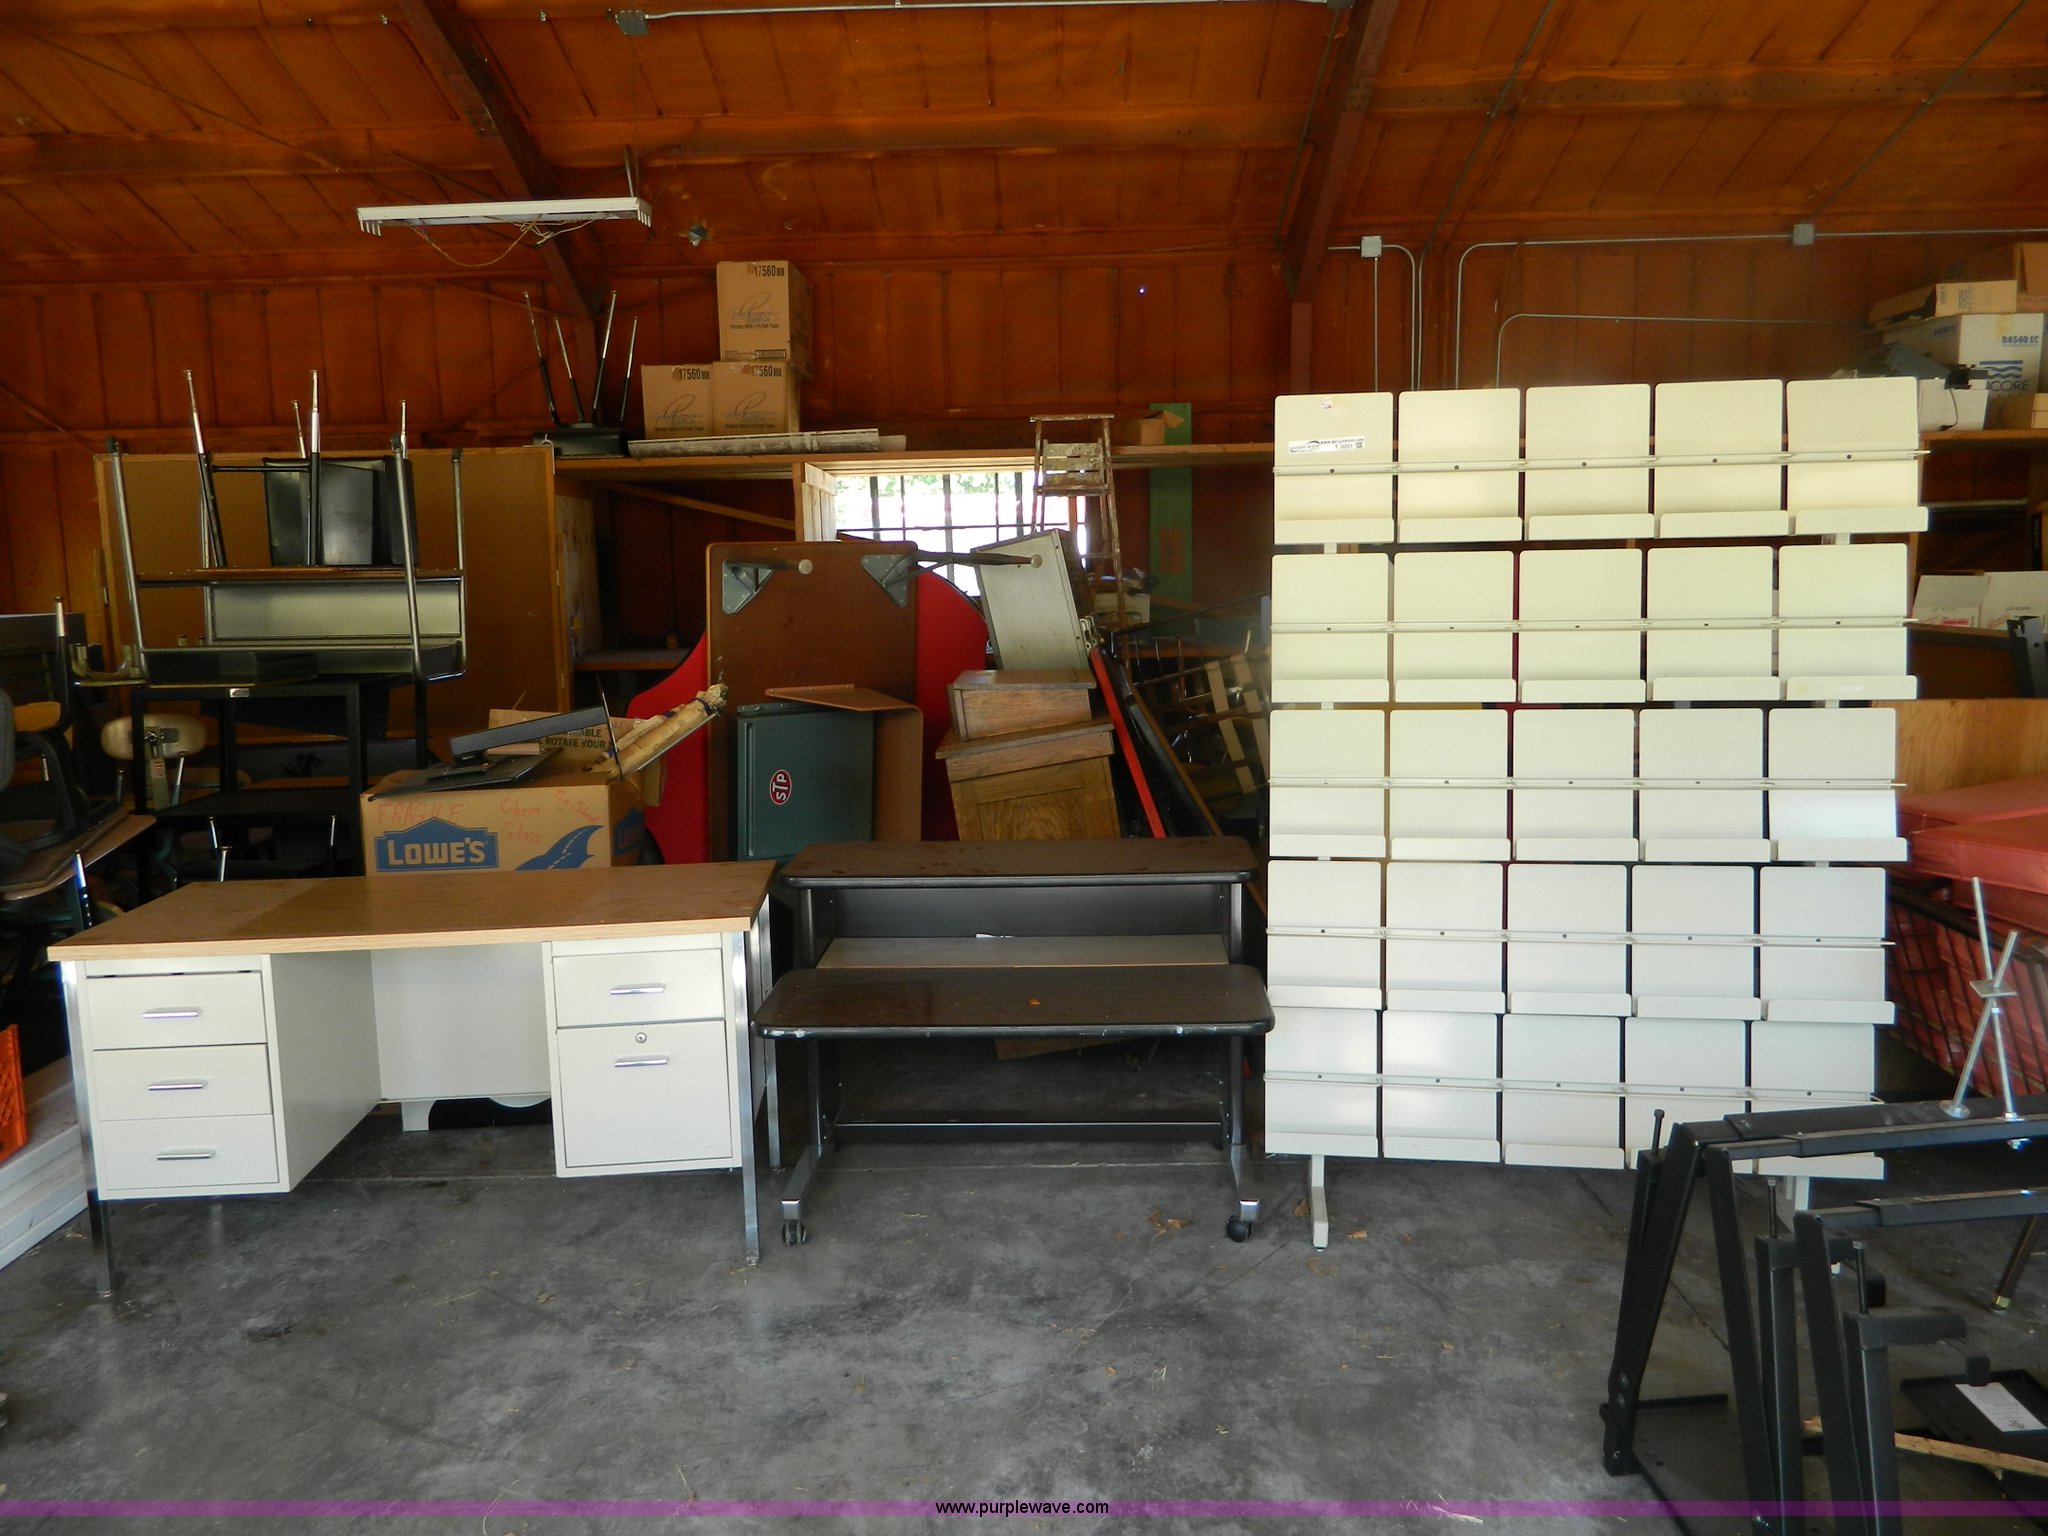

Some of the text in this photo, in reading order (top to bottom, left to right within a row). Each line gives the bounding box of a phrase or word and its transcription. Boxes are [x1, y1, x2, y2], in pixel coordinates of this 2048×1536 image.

[545, 737, 579, 747] ROTATE
[581, 739, 606, 749] YOUR
[772, 773, 789, 801] STP
[377, 802, 465, 827] FRAGILE
[499, 796, 542, 816] Chem
[501, 821, 543, 843] Glass
